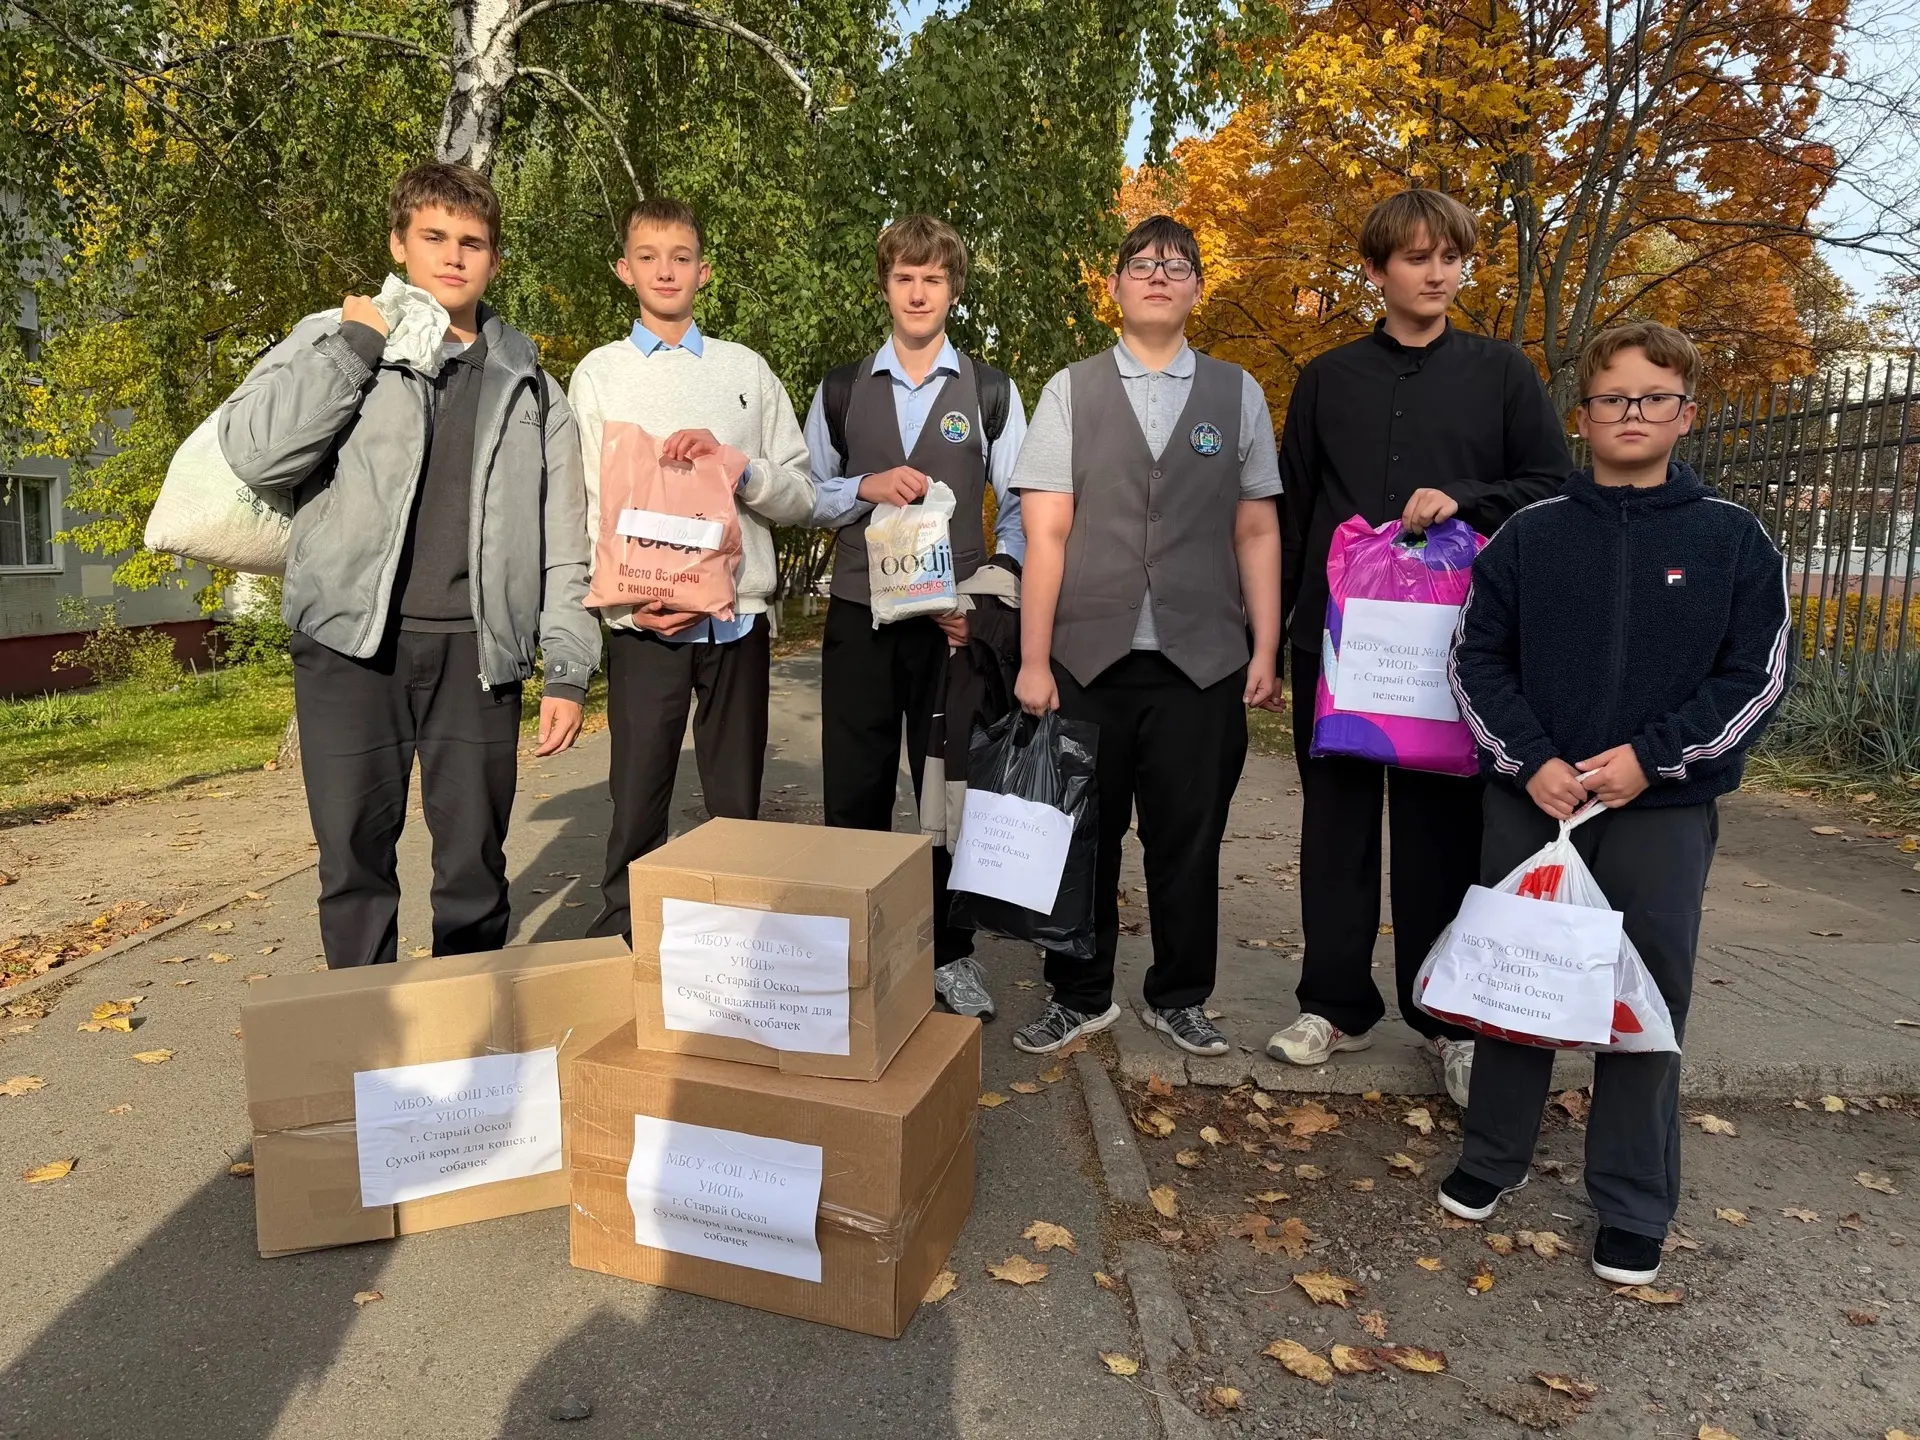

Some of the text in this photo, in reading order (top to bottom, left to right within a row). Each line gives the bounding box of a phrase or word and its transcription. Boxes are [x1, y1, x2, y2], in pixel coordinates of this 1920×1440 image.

[619, 563, 651, 579] Место
[881, 544, 952, 578] oodji
[618, 583, 674, 598] с книгами
[1347, 640, 1446, 658] МБОУ «СОШ №16
[1378, 658, 1418, 671] УИОП»
[1365, 673, 1403, 685] Старый
[1407, 677, 1439, 688] Оскол
[1373, 691, 1415, 702] пеленки
[984, 826, 1015, 840] УИОП»
[992, 815, 1018, 828] «СОШ
[1020, 820, 1040, 833] №16
[972, 838, 1000, 852] Старый
[1003, 845, 1030, 860] Оскол
[978, 857, 1002, 868] крупы
[694, 934, 812, 959] МБОУ «СОШ №16 с
[1461, 932, 1583, 970] МБОУ «СОШ №16 с
[731, 956, 775, 972] УИОП»
[1493, 959, 1539, 979] УИОП»
[705, 973, 800, 993] г. Старый Оскол
[1465, 973, 1563, 1003] г. Старый Оскол
[678, 986, 832, 1017] Сухой и влажный корм для
[1472, 993, 1551, 1021] медикаменты
[710, 1009, 742, 1023] кошек
[754, 1018, 800, 1031] собачек
[394, 1083, 524, 1112] МБОУ «СОШ №16 с
[436, 1108, 485, 1124] УИОП»
[410, 1121, 512, 1144] г. Старый Оскол
[386, 1135, 537, 1169] Сухой корм для кошек и
[439, 1158, 487, 1174] собачек
[667, 1152, 705, 1170] МБОУ
[780, 1177, 786, 1186] с
[699, 1180, 744, 1200] УИОП»
[673, 1197, 768, 1225] г. Старый Оскол
[654, 1207, 689, 1222] Сухой
[692, 1216, 720, 1230] корм
[724, 1225, 744, 1234] для
[747, 1228, 784, 1242] кошек
[704, 1231, 748, 1247] собачек
